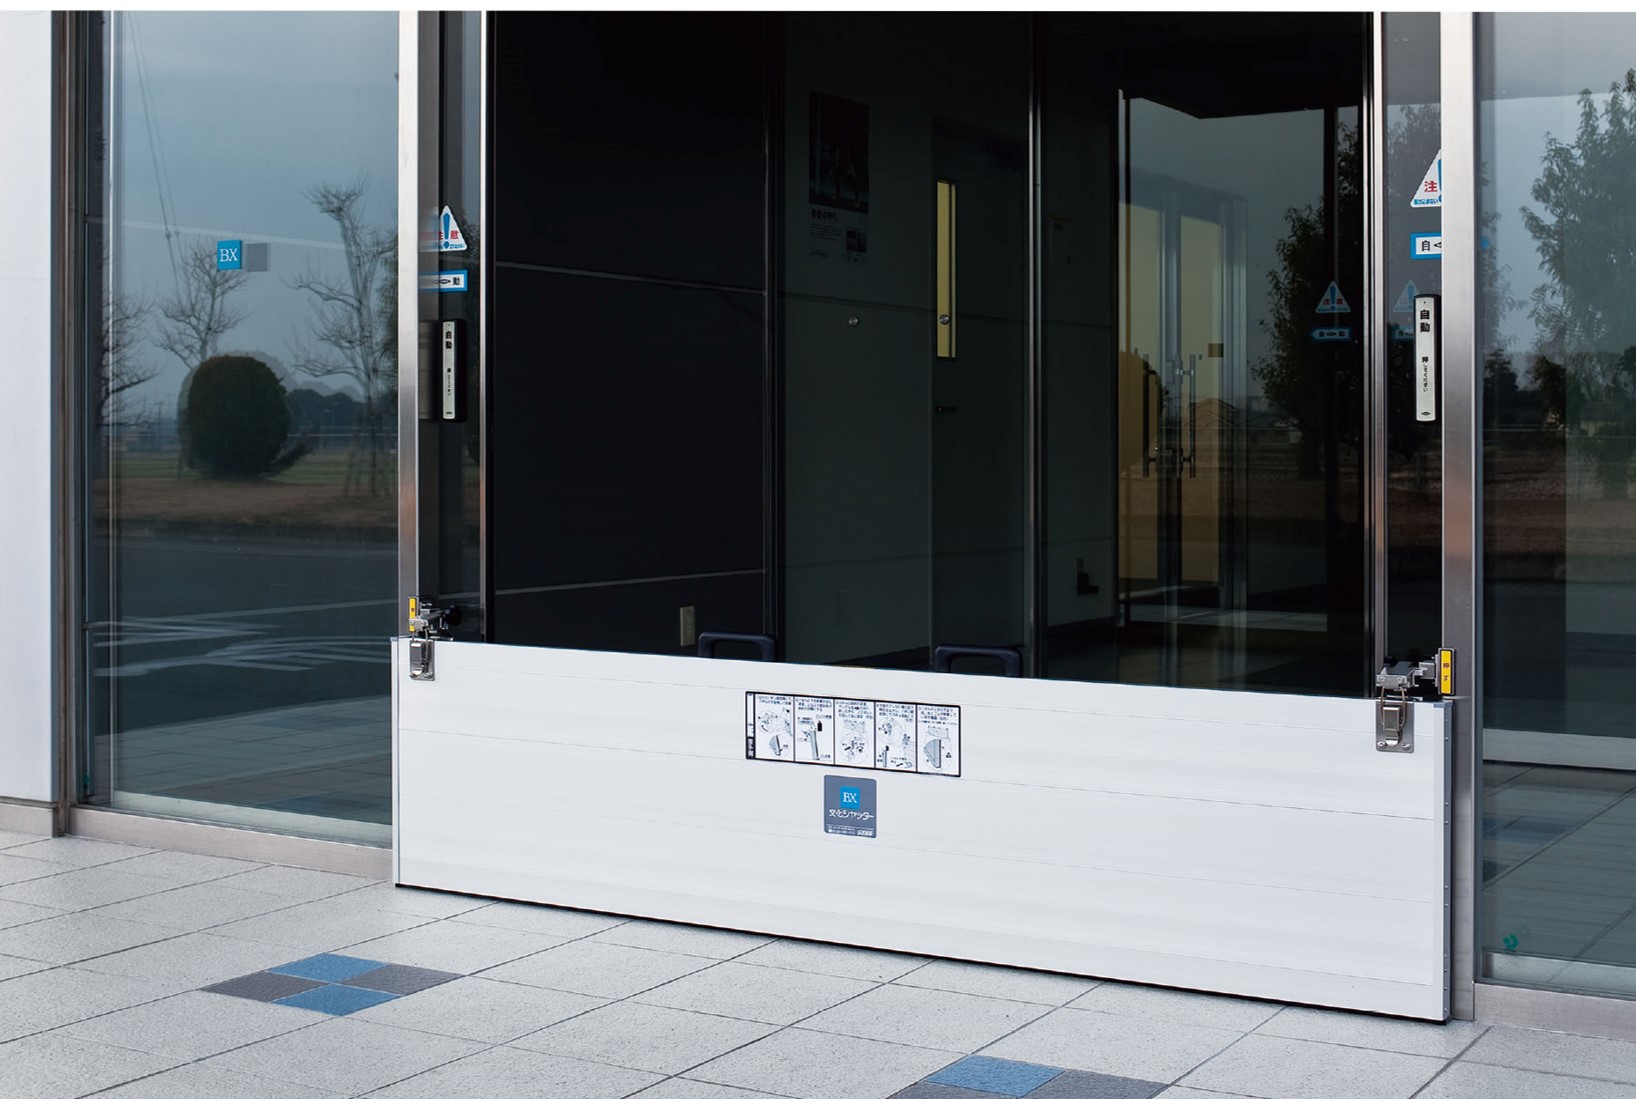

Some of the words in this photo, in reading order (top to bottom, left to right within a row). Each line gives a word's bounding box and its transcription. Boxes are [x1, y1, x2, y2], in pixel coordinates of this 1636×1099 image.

[219, 248, 239, 262] BX
[1420, 309, 1431, 333] 自動
[842, 791, 858, 804] BX
[828, 808, 875, 821] 文化シャッター
